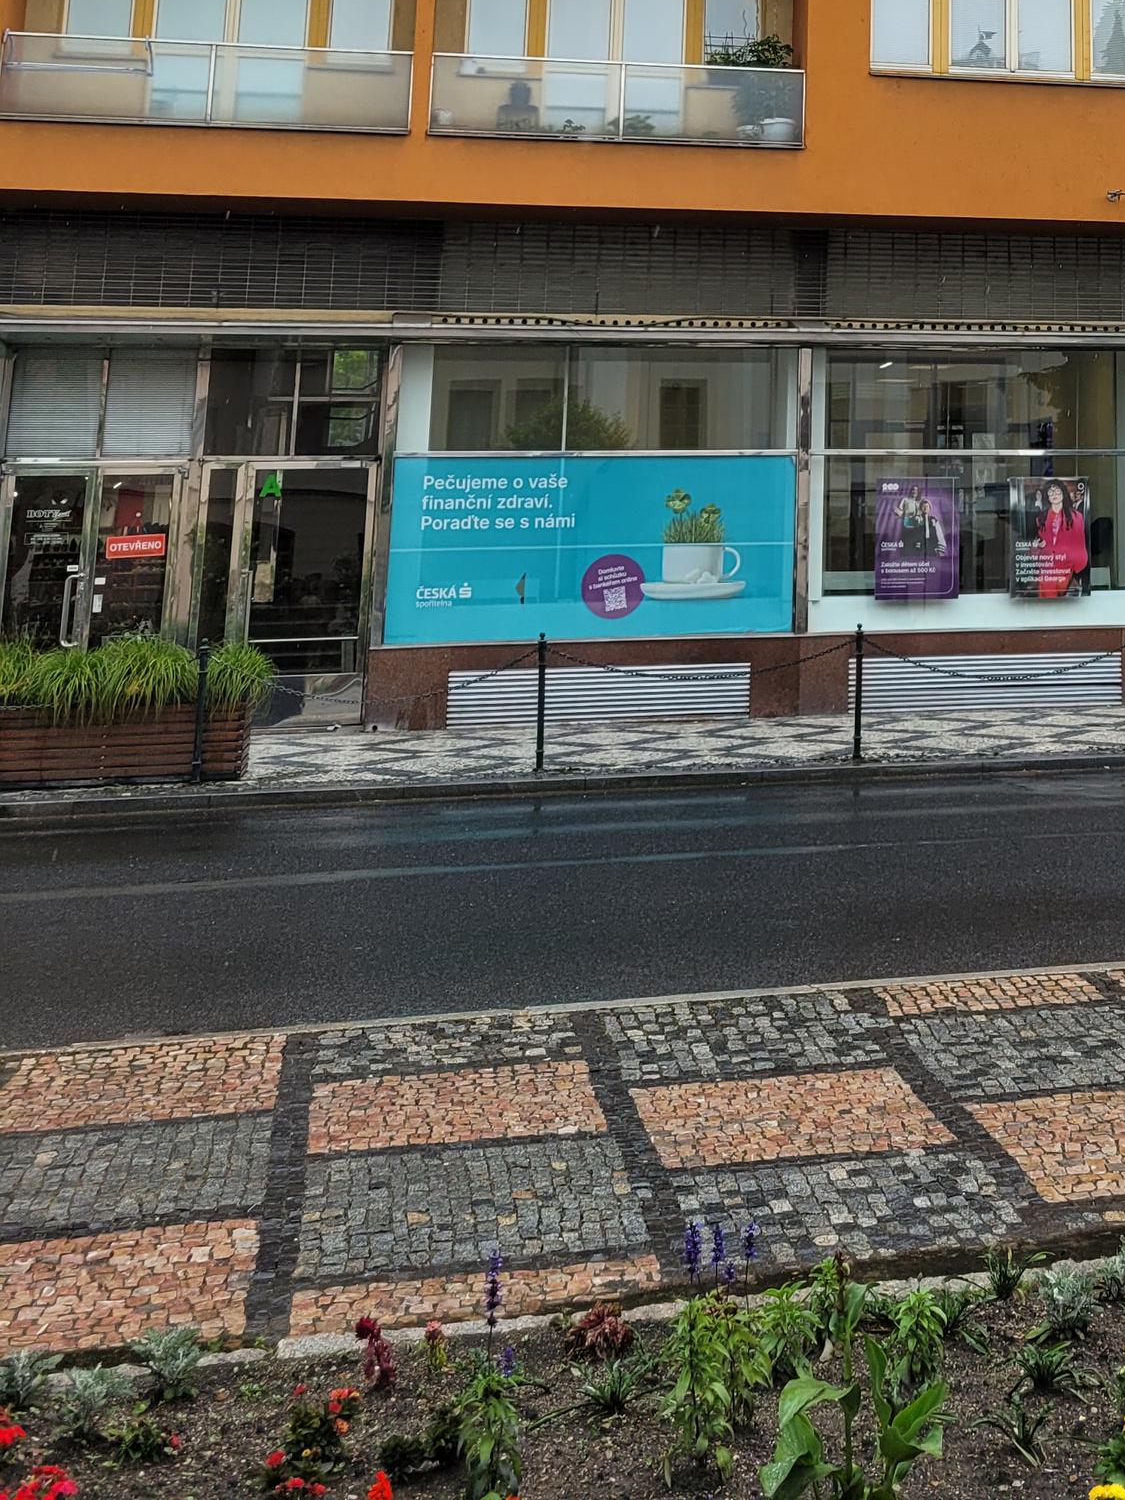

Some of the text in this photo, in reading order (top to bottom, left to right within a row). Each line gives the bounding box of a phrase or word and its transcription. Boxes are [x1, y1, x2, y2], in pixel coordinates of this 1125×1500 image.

[259, 474, 282, 498] A
[423, 473, 568, 493] Pečujeme o vaše
[422, 493, 553, 511] finanční zdraví.
[421, 513, 576, 531] Poraďte se s námi
[109, 540, 162, 552] OTEVŘENO
[416, 584, 457, 599] ČESKÁ
